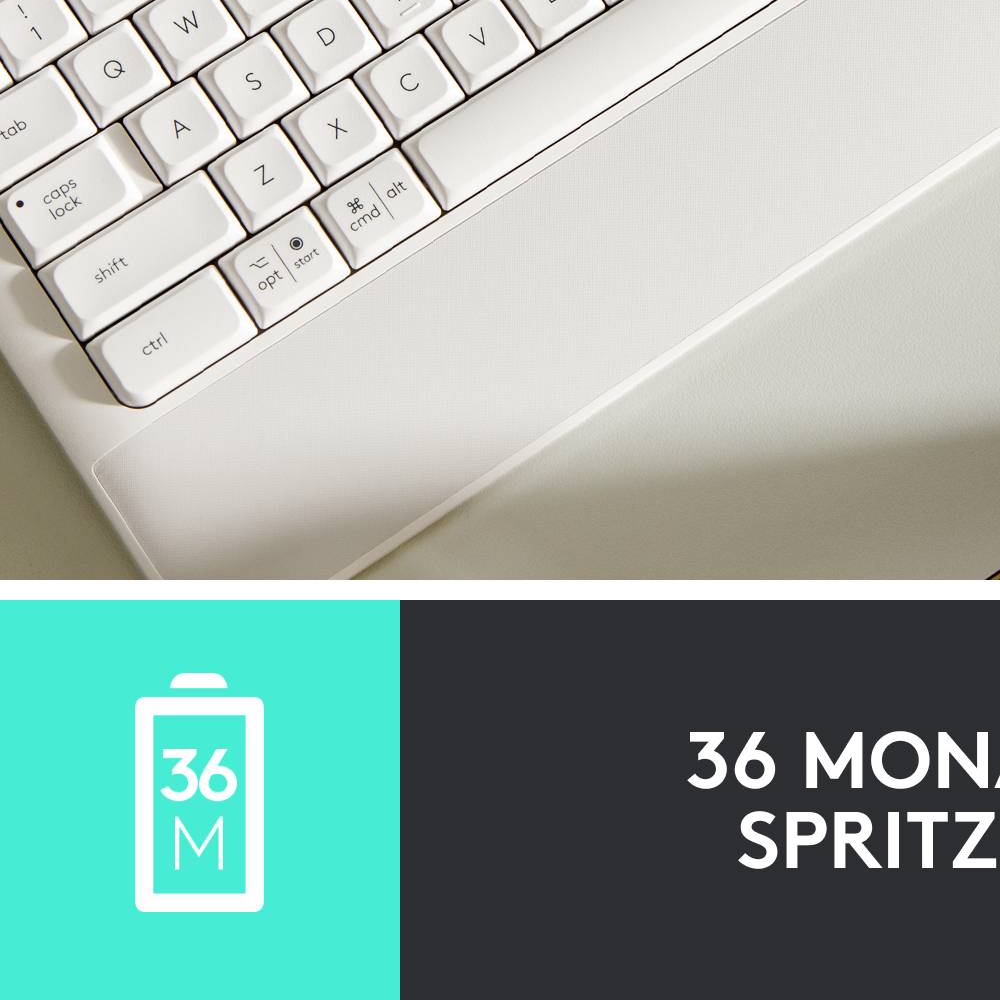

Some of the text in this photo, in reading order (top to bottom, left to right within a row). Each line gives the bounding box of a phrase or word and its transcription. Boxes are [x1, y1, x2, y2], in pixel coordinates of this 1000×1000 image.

[17, 4, 28, 19] !
[172, 9, 199, 35] W
[30, 26, 43, 41] 1
[316, 27, 336, 47] D
[468, 26, 486, 46] V
[103, 59, 126, 79] Q
[245, 72, 262, 91] S
[399, 72, 420, 92] C
[0, 118, 27, 140] tab
[173, 119, 192, 140] A
[327, 117, 348, 140] X
[253, 163, 275, 187] Z
[43, 179, 77, 205] caps
[386, 181, 408, 199] alt
[48, 196, 82, 220] lock
[349, 205, 382, 232] cmd
[293, 247, 320, 269] start
[94, 257, 129, 284] shift
[257, 268, 282, 291] opt
[142, 331, 168, 356] ctrl
